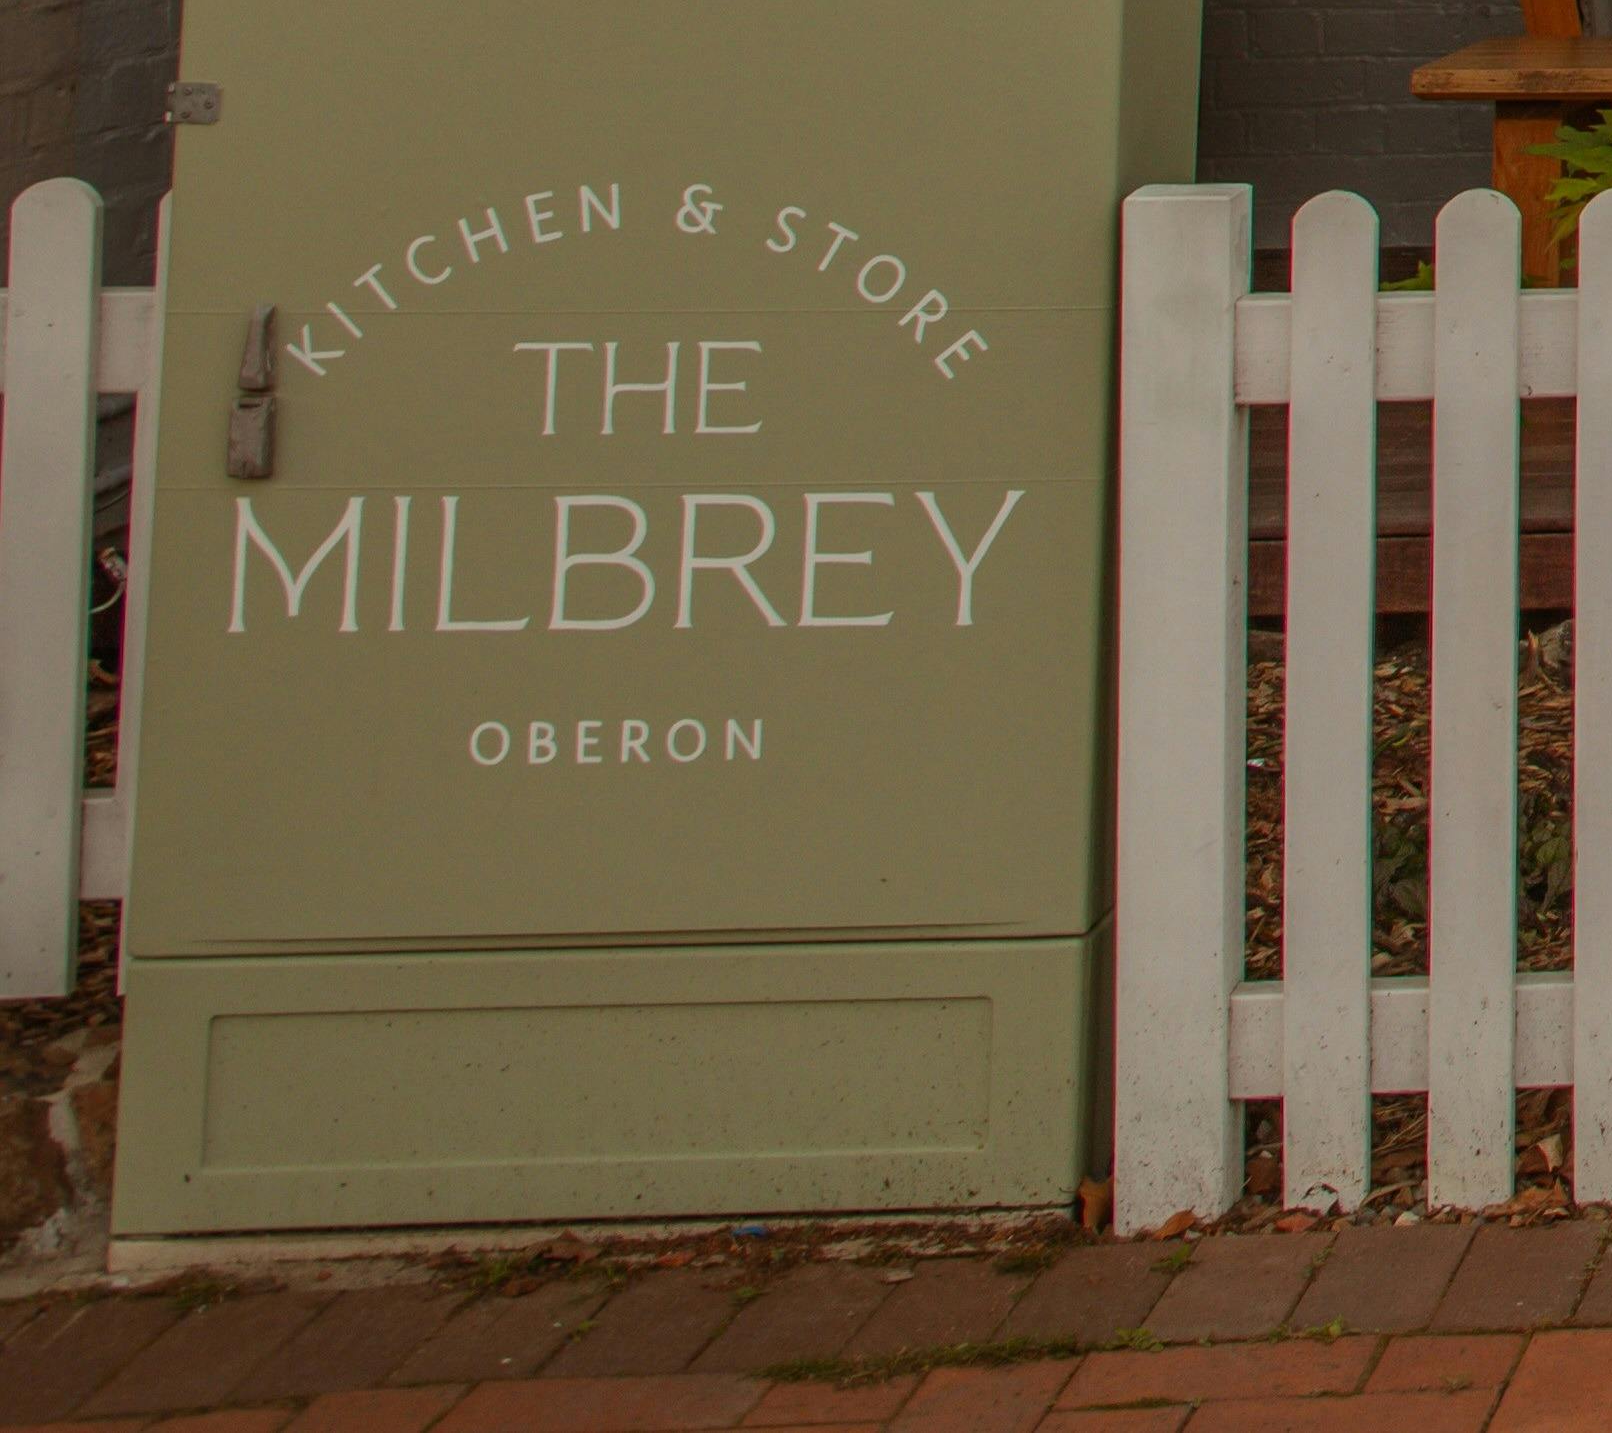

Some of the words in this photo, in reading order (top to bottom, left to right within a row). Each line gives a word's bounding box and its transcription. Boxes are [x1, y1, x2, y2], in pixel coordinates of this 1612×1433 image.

[285, 183, 621, 377] KITCHEN
[675, 183, 724, 235] &
[766, 206, 989, 380] STORE
[512, 340, 763, 436] THE
[227, 489, 1027, 633] MILBREY
[468, 717, 764, 766] OBERON
